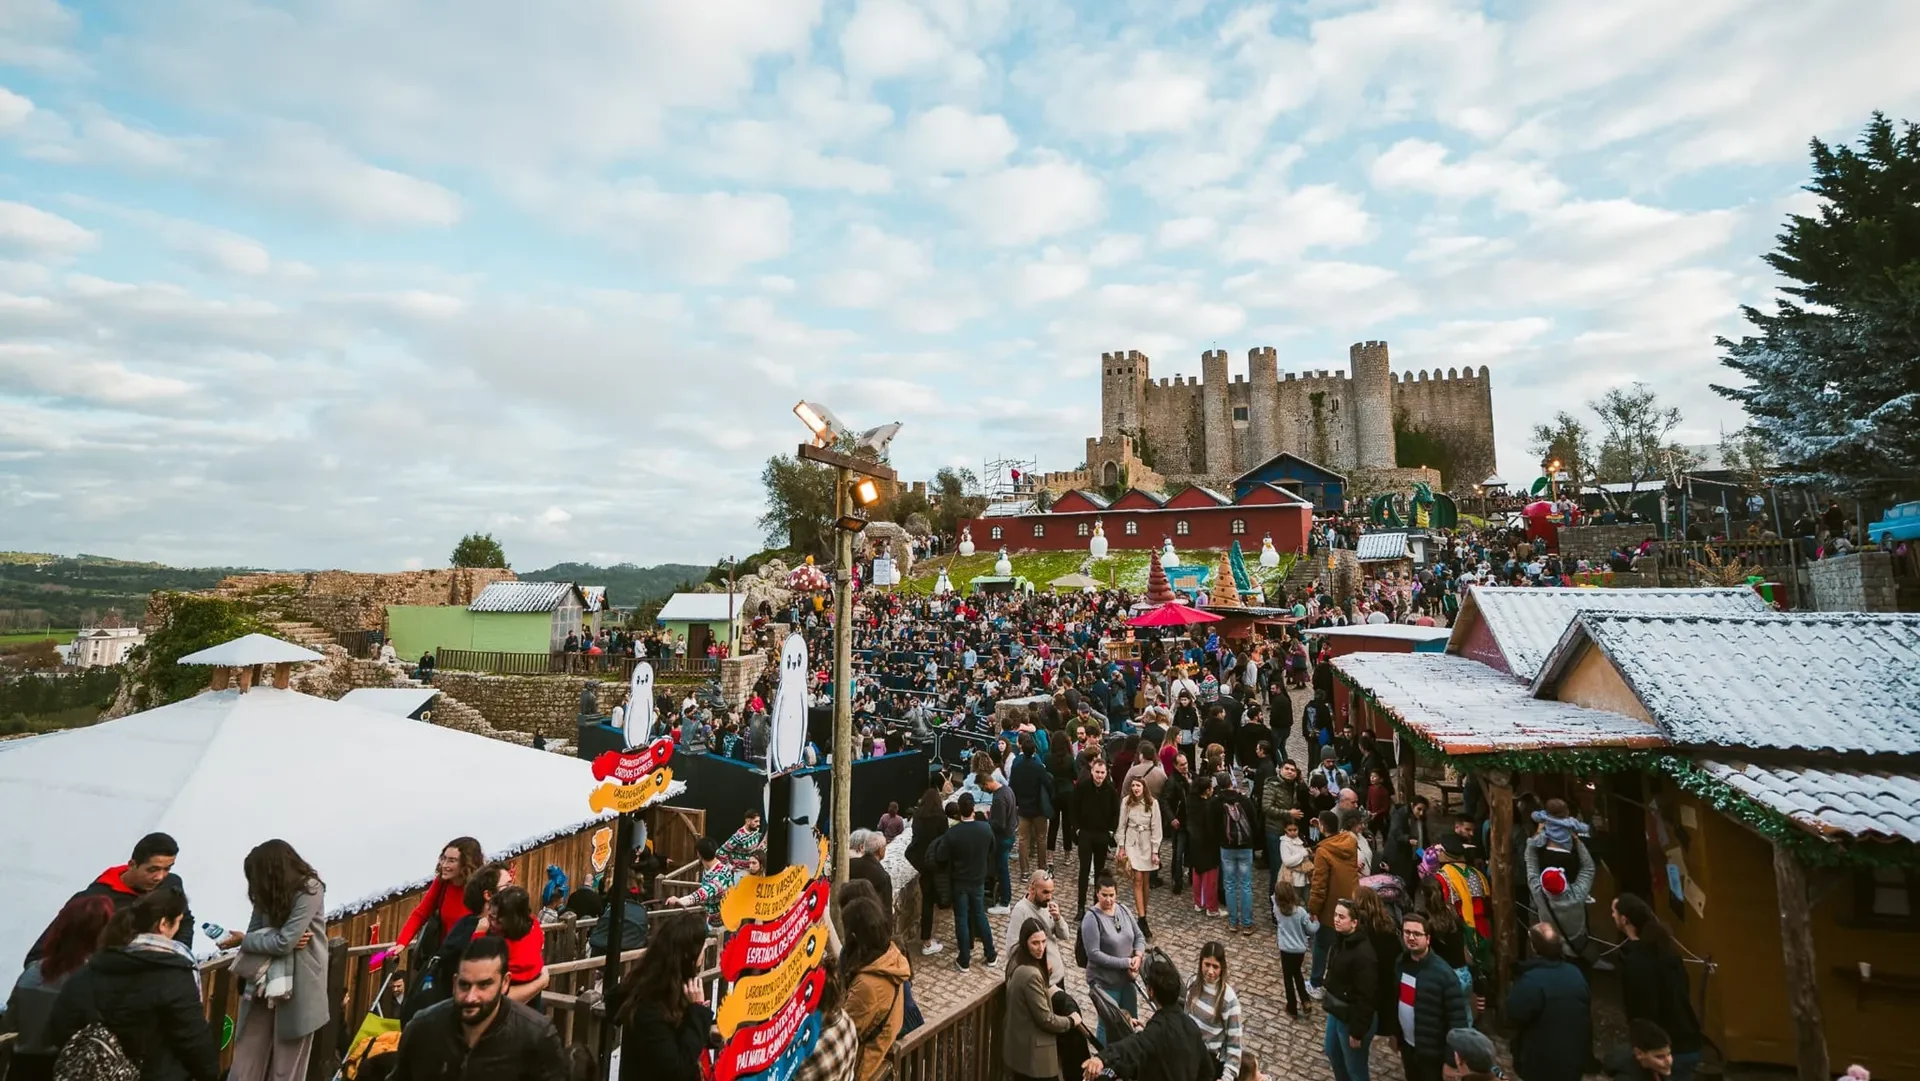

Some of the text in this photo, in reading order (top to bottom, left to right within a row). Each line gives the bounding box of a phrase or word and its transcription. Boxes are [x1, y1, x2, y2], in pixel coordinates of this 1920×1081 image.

[756, 882, 775, 899] SLIDE
[755, 901, 771, 916] SLIDE
[747, 1000, 770, 1016] POTIONS
[736, 1049, 749, 1072] PAI
[788, 1000, 806, 1034] CLAUS
